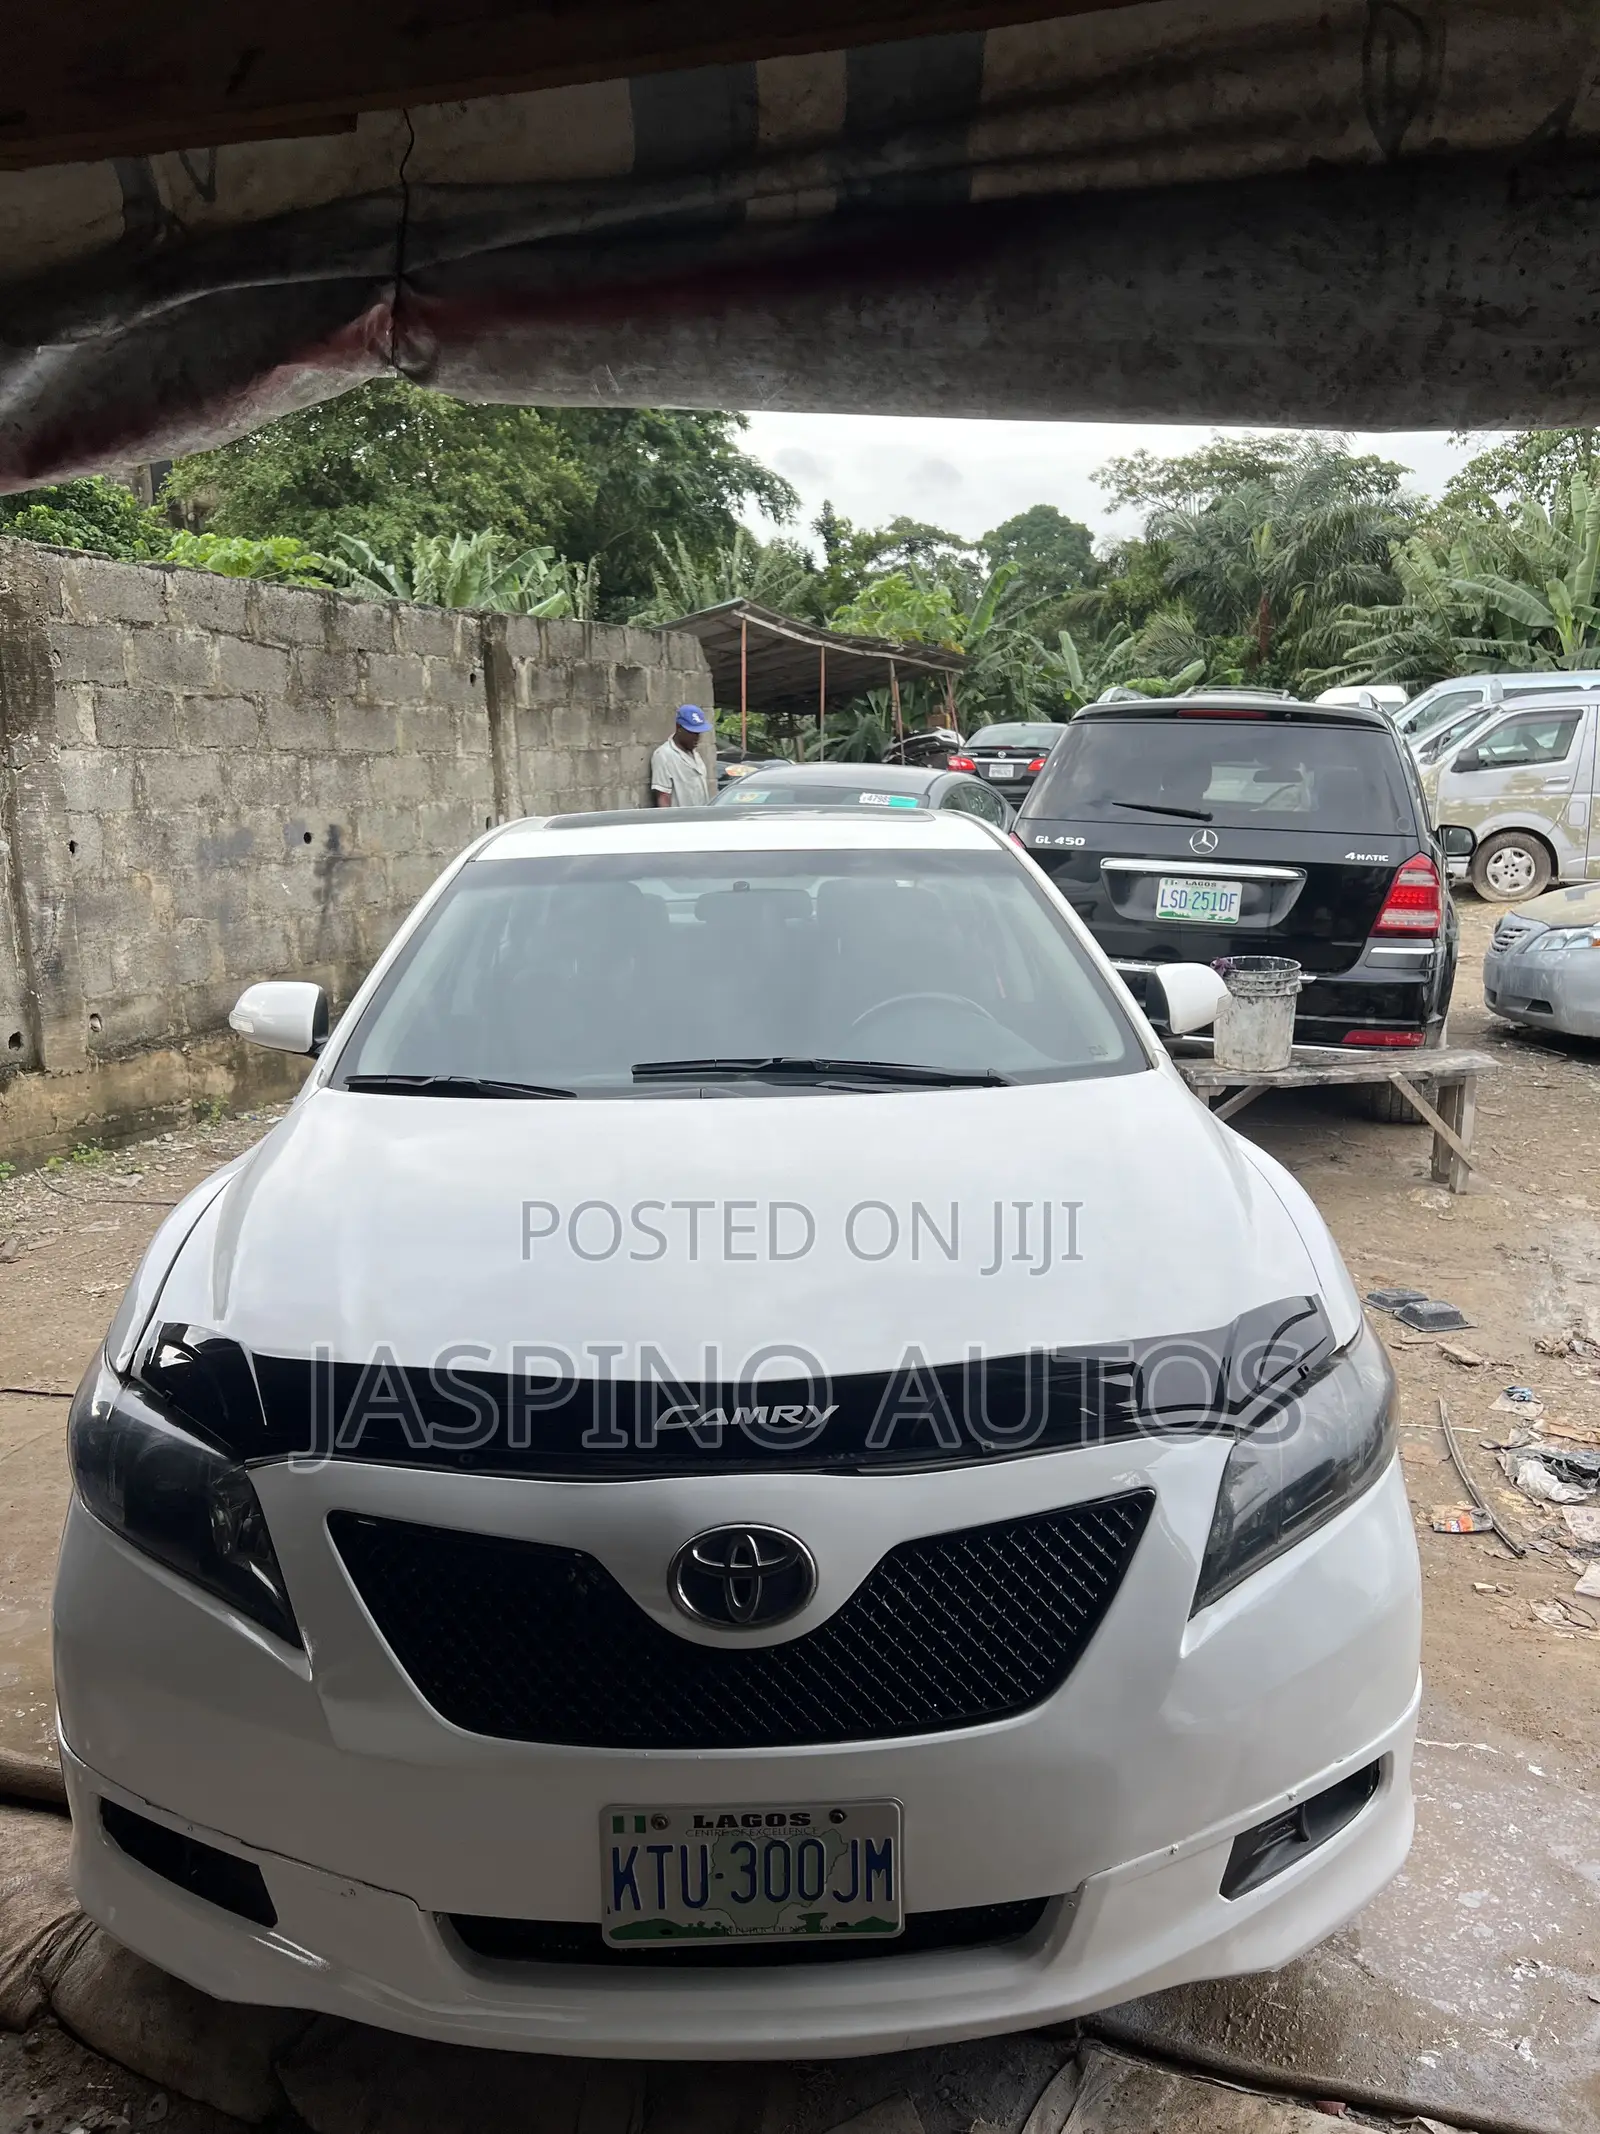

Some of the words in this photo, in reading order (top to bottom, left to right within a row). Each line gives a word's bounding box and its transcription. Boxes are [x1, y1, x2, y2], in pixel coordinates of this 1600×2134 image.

[1035, 835, 1051, 844] GL
[1054, 836, 1086, 846] 450
[654, 1405, 840, 1430] CAMRY
[693, 1812, 811, 1829] LAGOS
[685, 1829, 729, 1838] CENTRE
[731, 1828, 748, 1837] OF
[750, 1826, 818, 1837] EXCELLENCE
